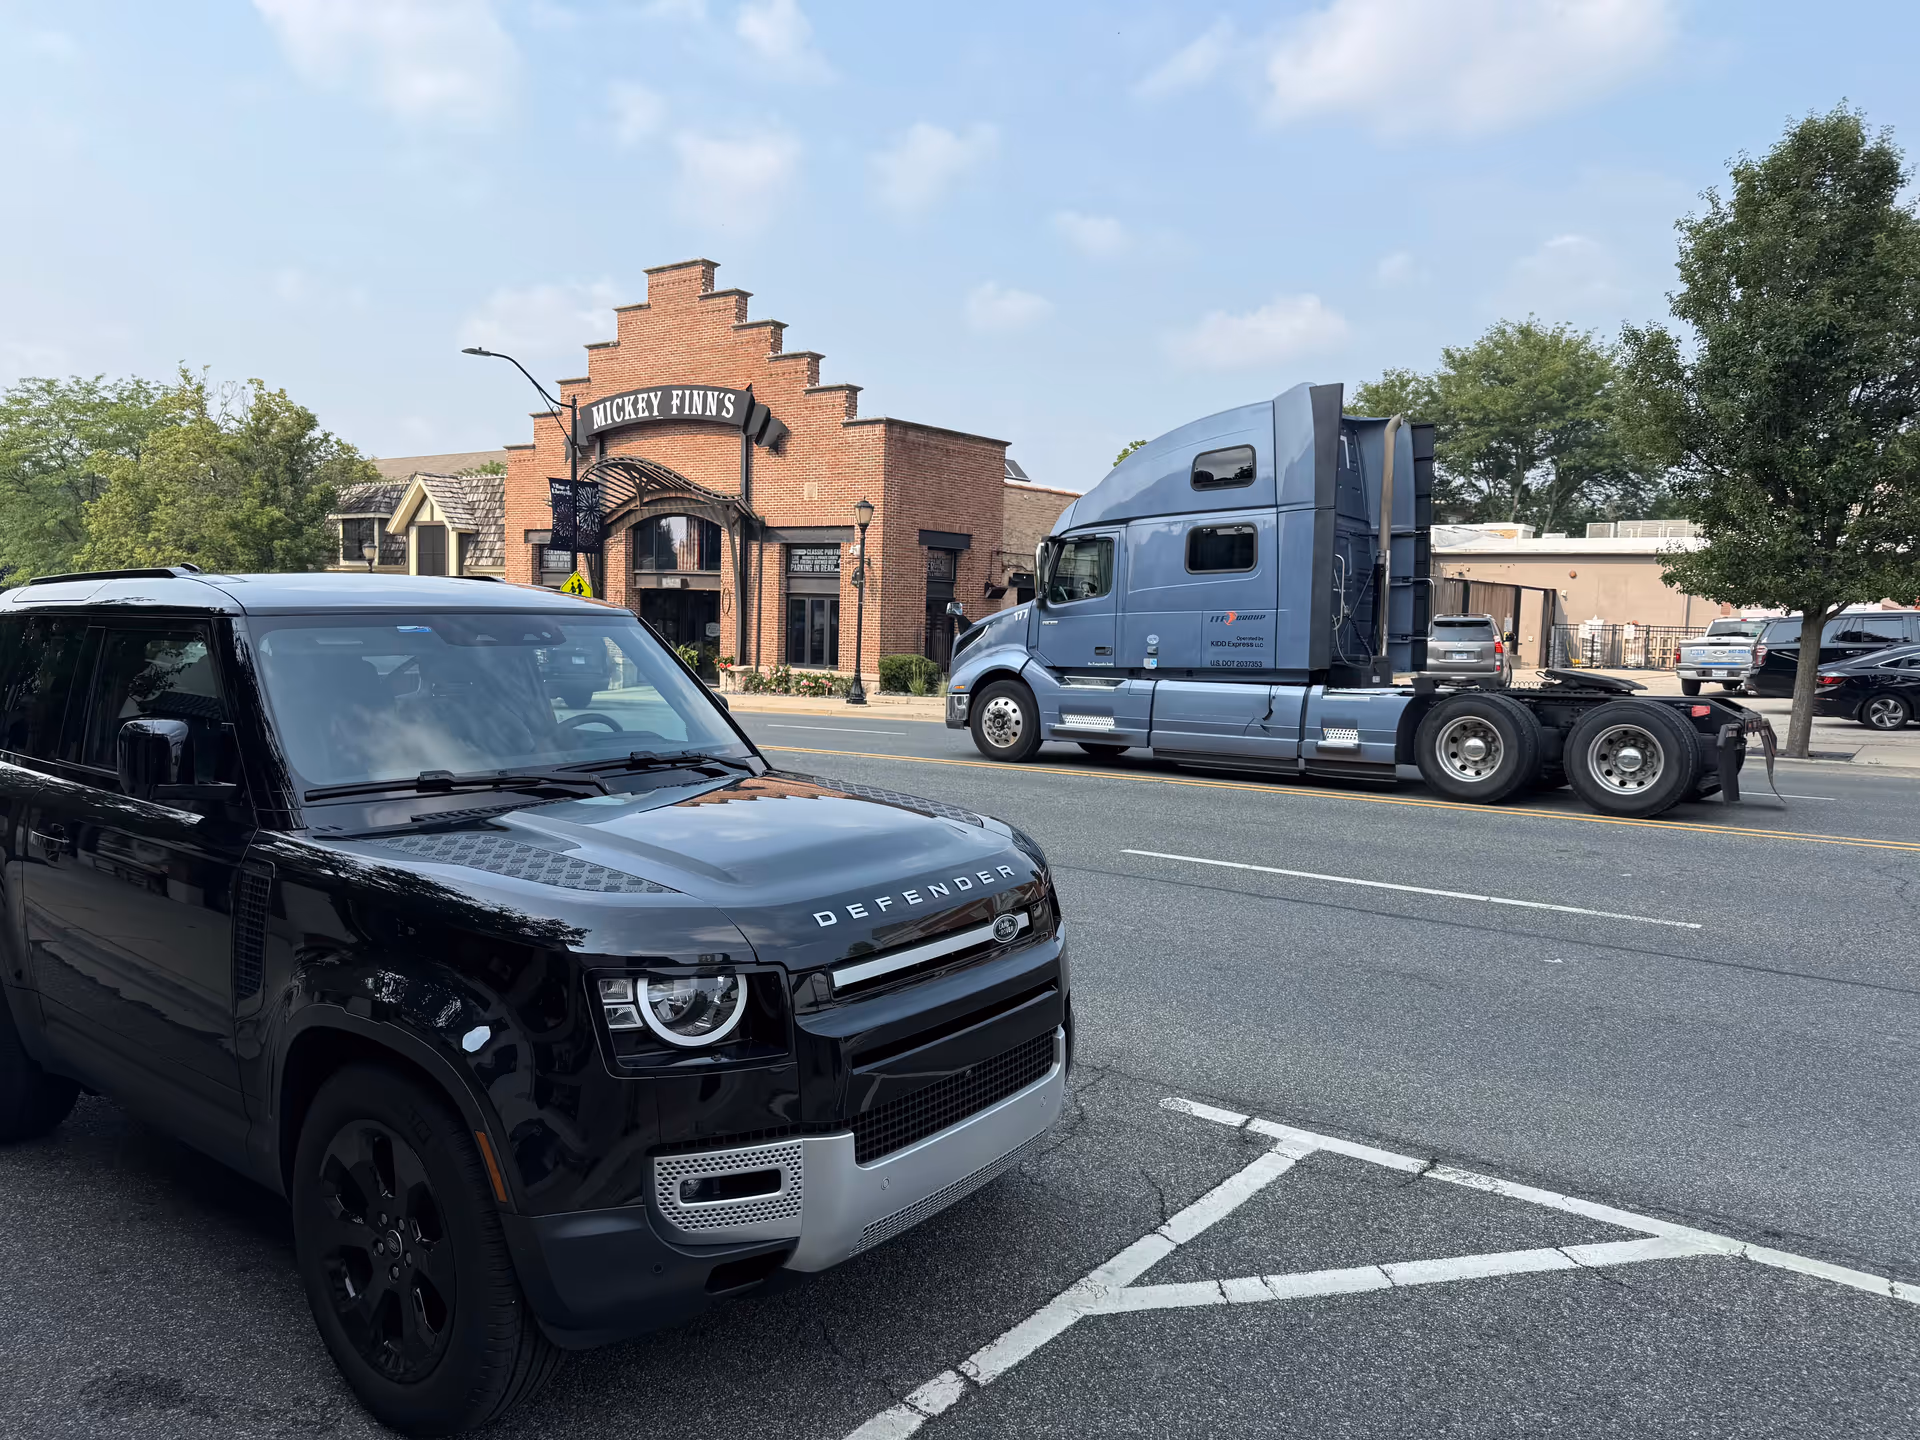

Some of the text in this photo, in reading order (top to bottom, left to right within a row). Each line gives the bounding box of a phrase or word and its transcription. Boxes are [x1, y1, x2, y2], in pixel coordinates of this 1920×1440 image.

[591, 390, 736, 430] MICKEY FINN'S
[1013, 608, 1029, 621] 177
[812, 864, 1015, 927] DEFENDER
